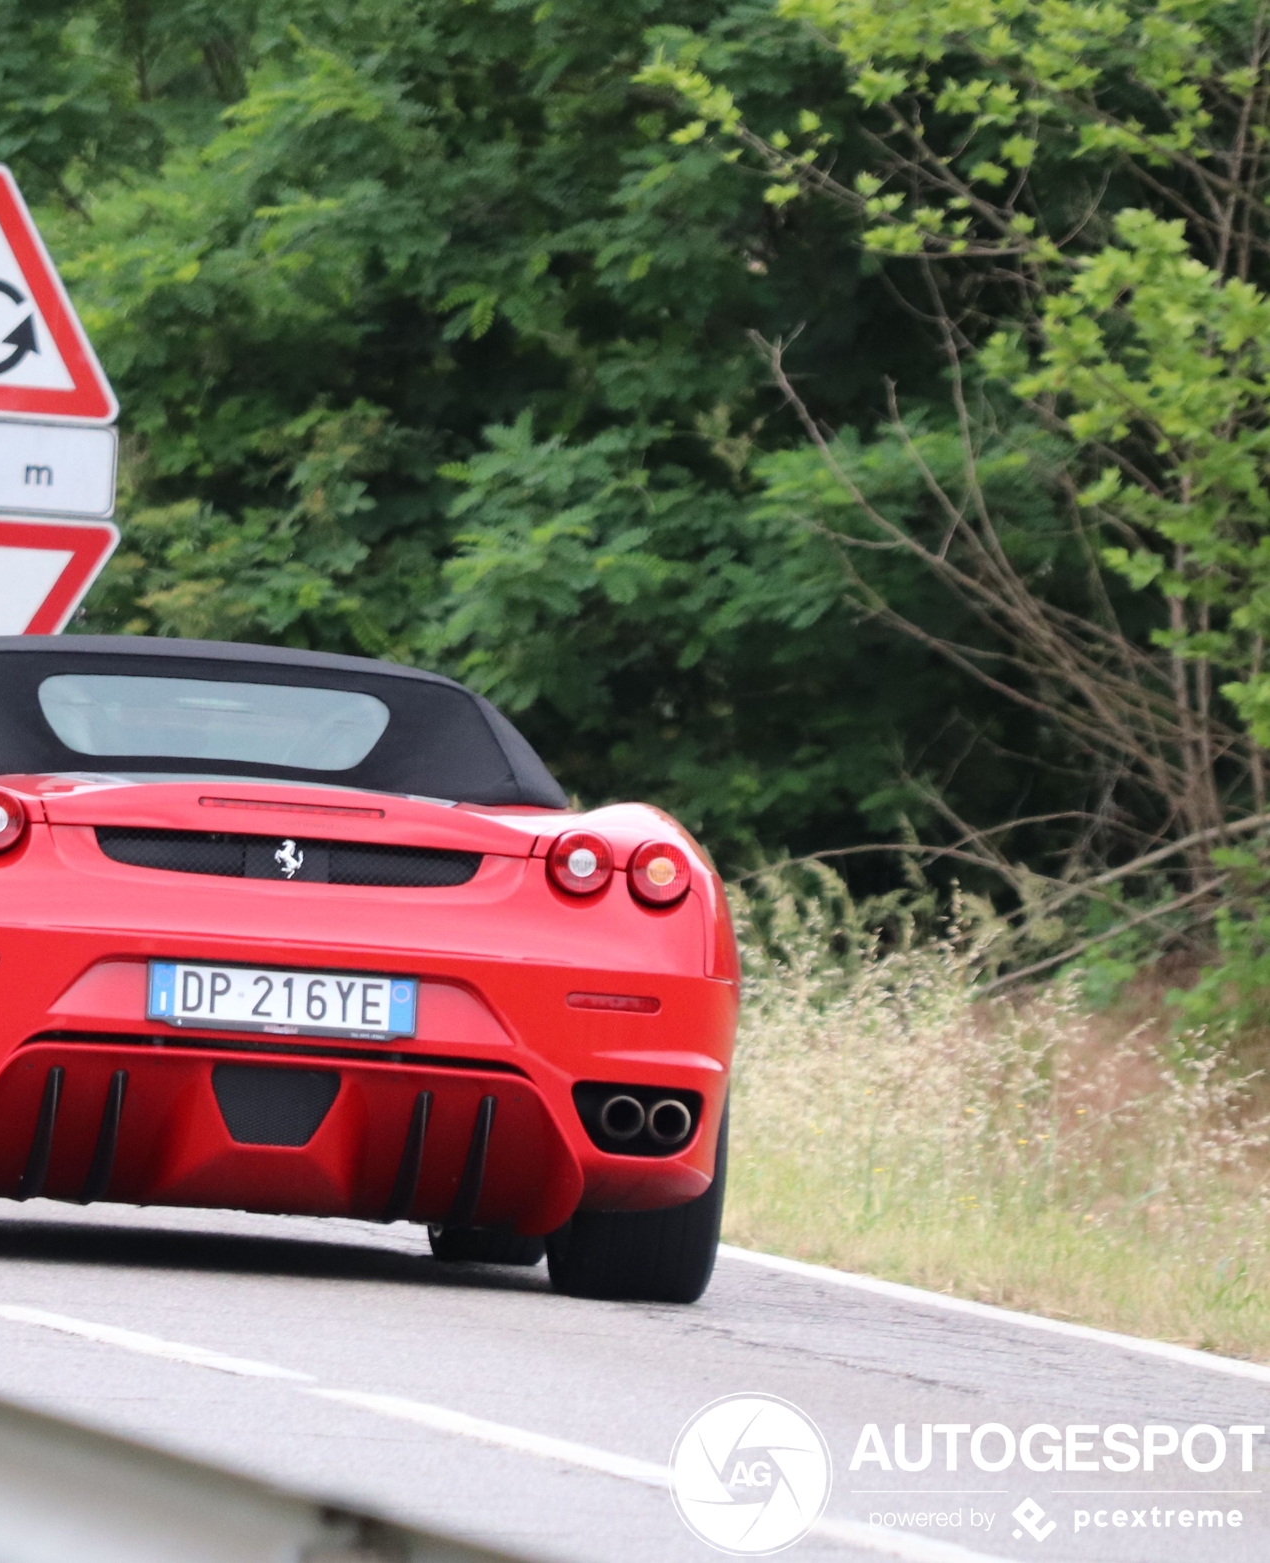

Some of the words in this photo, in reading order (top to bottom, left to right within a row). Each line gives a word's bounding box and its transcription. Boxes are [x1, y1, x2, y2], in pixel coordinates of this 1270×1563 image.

[24, 464, 53, 486] m
[181, 970, 232, 1014] DP
[251, 975, 384, 1025] 216YE
